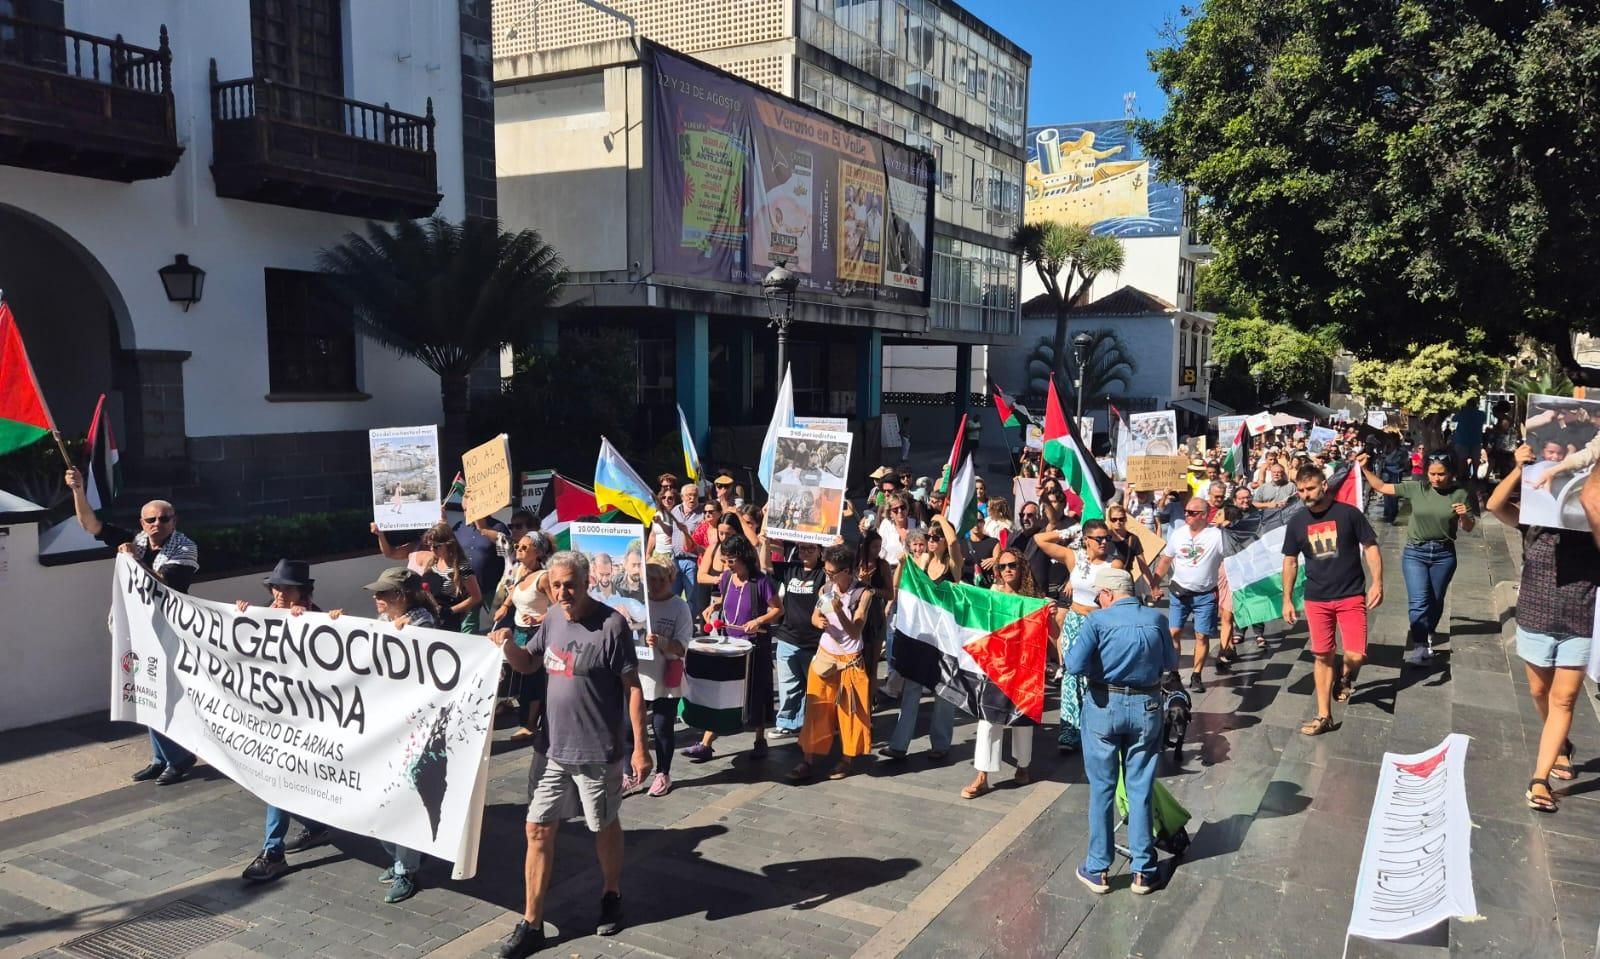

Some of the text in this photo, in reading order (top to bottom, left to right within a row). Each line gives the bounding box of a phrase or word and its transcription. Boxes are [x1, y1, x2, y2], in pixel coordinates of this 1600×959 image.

[671, 78, 678, 89] Y
[679, 81, 690, 95] 23
[692, 85, 705, 100] DE
[706, 91, 741, 112] AGOSTO
[773, 107, 866, 155] Verano en El Valle
[466, 455, 478, 468] NO
[379, 522, 409, 530] Palestina
[233, 615, 462, 691] GENOCIDIO
[122, 682, 158, 699] CANARIAS
[122, 694, 158, 709] PALESTINA
[208, 650, 365, 734] PALESTINA
[187, 687, 205, 707] FIN
[204, 696, 221, 715] AL
[283, 726, 302, 746] DE
[300, 733, 344, 762] ARMAS
[211, 722, 279, 765] RELACIONES
[276, 752, 309, 776] CON
[313, 762, 362, 791] ISRAEL
[283, 776, 343, 805] boicotisrael.net
[1368, 832, 1447, 923] PALESTINA
